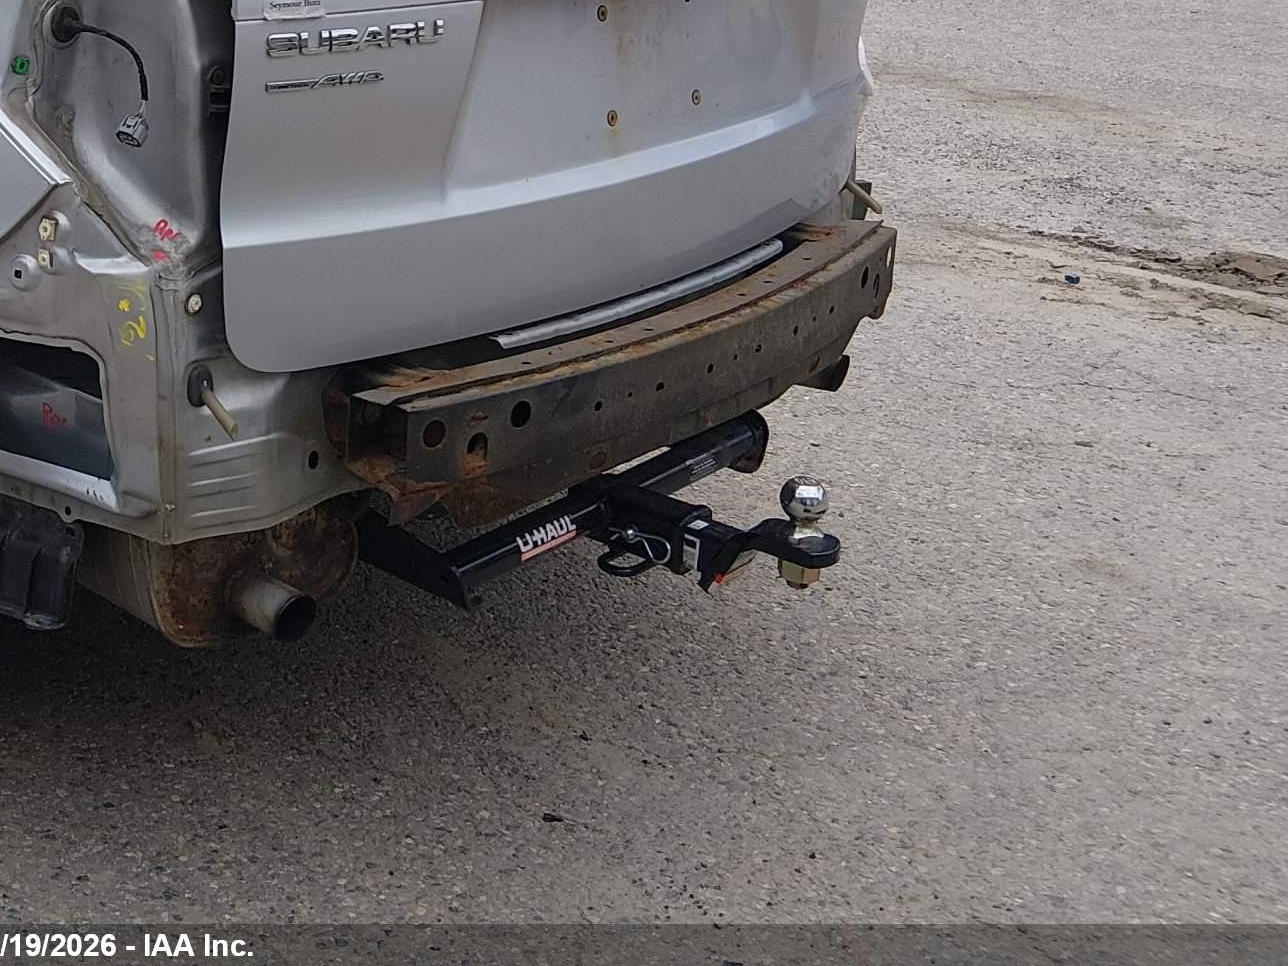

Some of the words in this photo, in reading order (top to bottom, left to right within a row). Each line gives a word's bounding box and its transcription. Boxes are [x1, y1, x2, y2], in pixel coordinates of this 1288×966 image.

[269, 1, 302, 10] Seymour
[265, 19, 445, 58] SUBARU
[515, 514, 577, 553] U-HAUL
